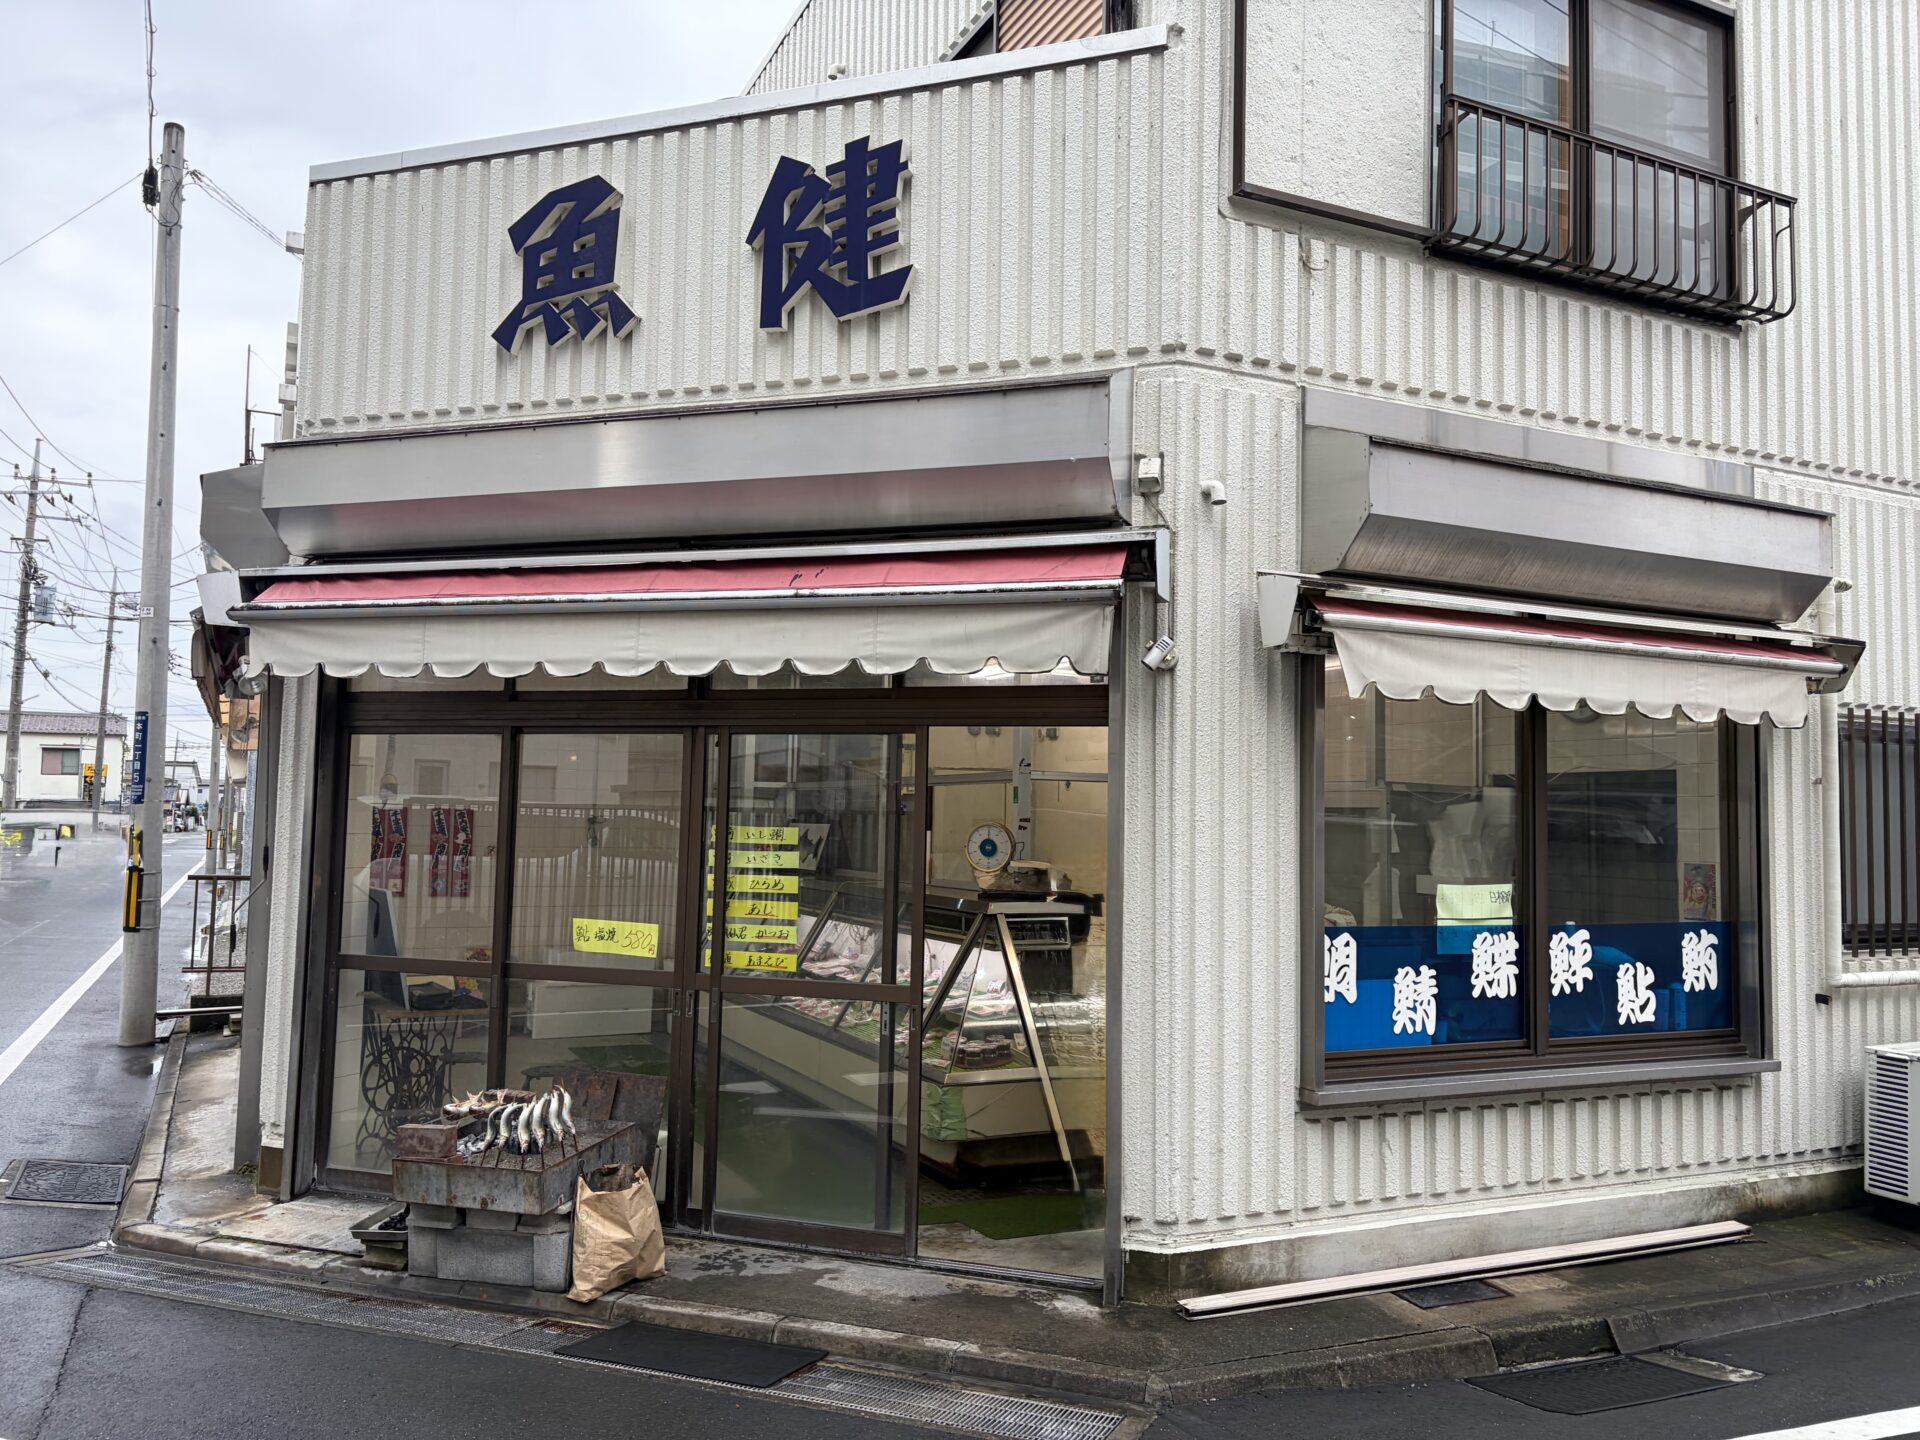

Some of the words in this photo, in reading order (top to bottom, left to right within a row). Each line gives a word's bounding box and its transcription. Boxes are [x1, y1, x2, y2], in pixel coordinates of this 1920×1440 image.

[749, 876, 785, 891] ひらめ
[747, 903, 776, 917] あじ
[757, 928, 790, 940] かつお
[746, 954, 787, 968] あまえび
[1391, 964, 1439, 1036] 鯖
[1616, 961, 1657, 1026] 鮎
